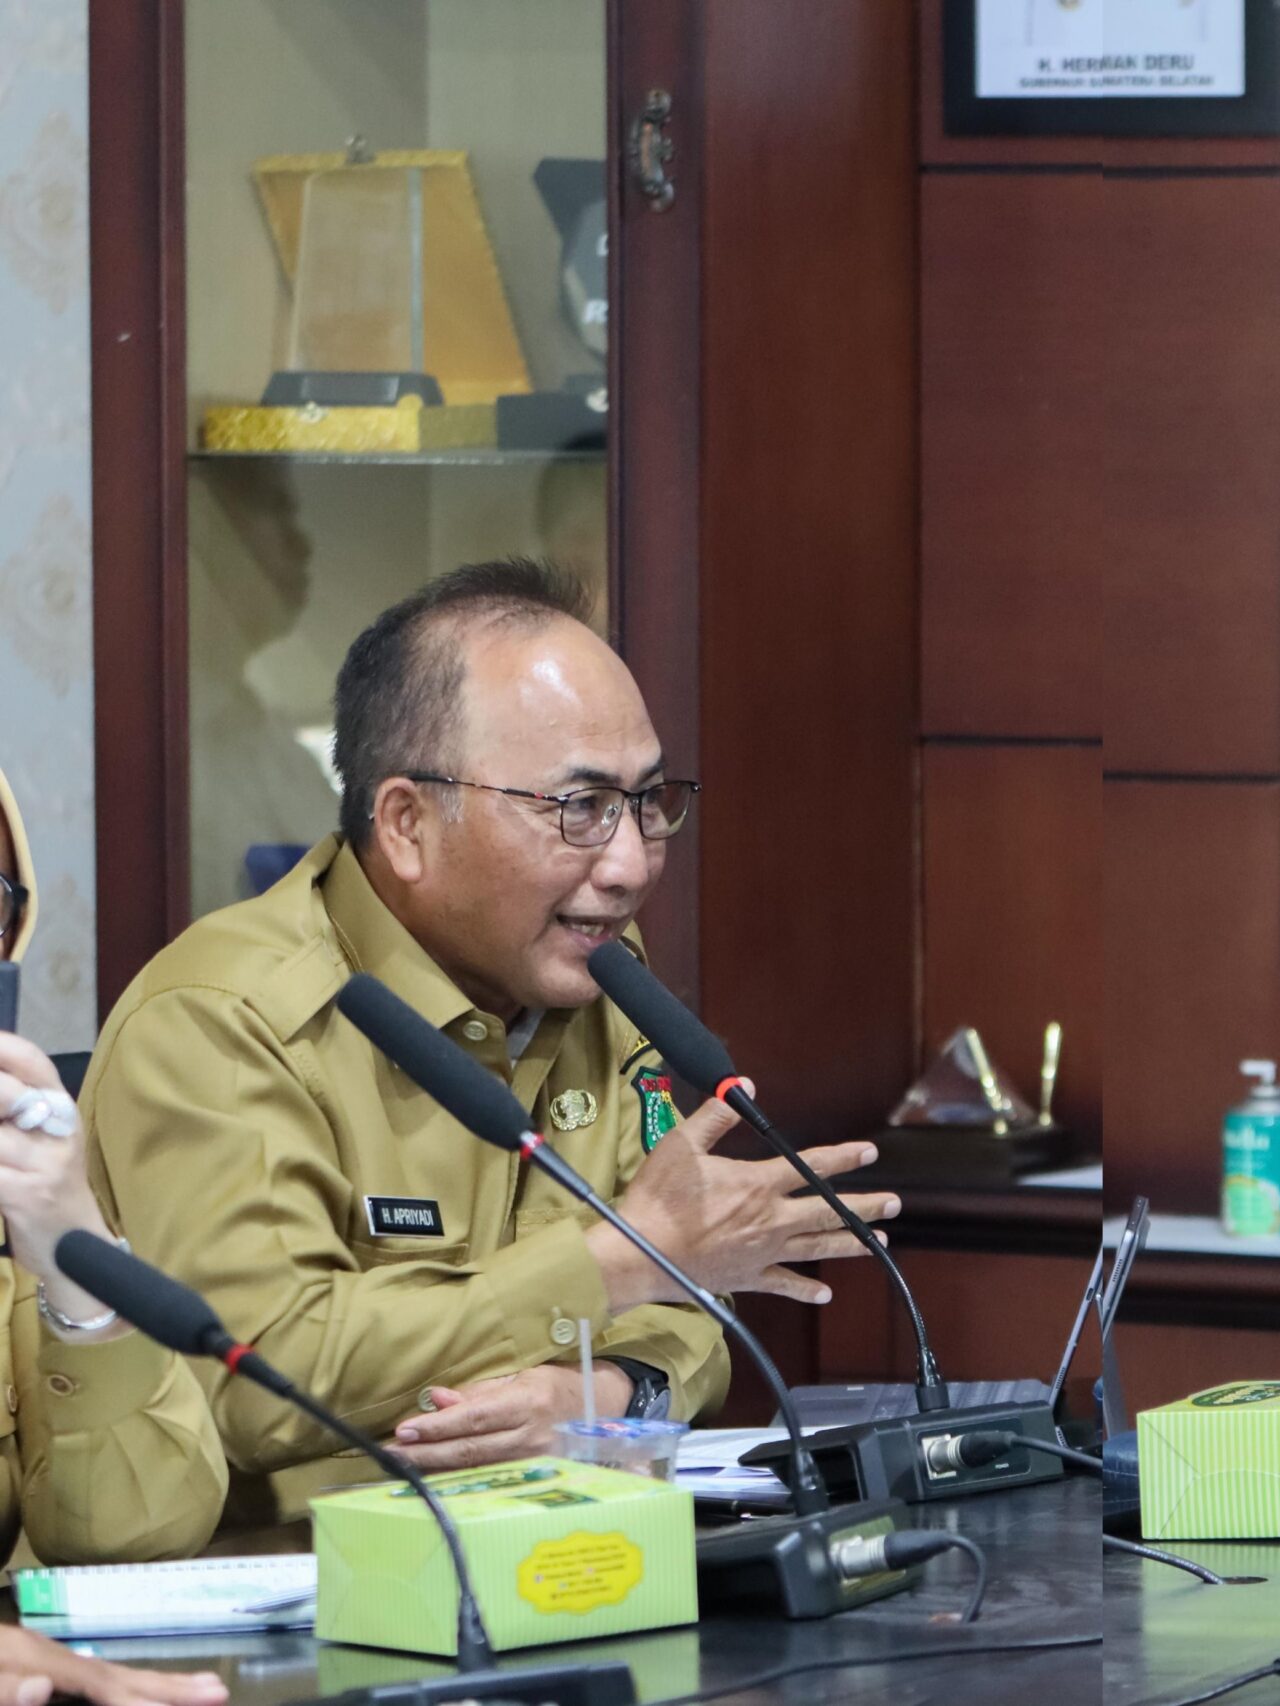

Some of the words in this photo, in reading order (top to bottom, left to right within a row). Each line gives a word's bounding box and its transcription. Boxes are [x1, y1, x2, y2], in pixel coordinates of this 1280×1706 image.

[1063, 55, 1137, 72] HERMAN
[1145, 54, 1195, 71] DERU
[382, 1208, 393, 1224] H.
[394, 1208, 434, 1227] APRIYADI
